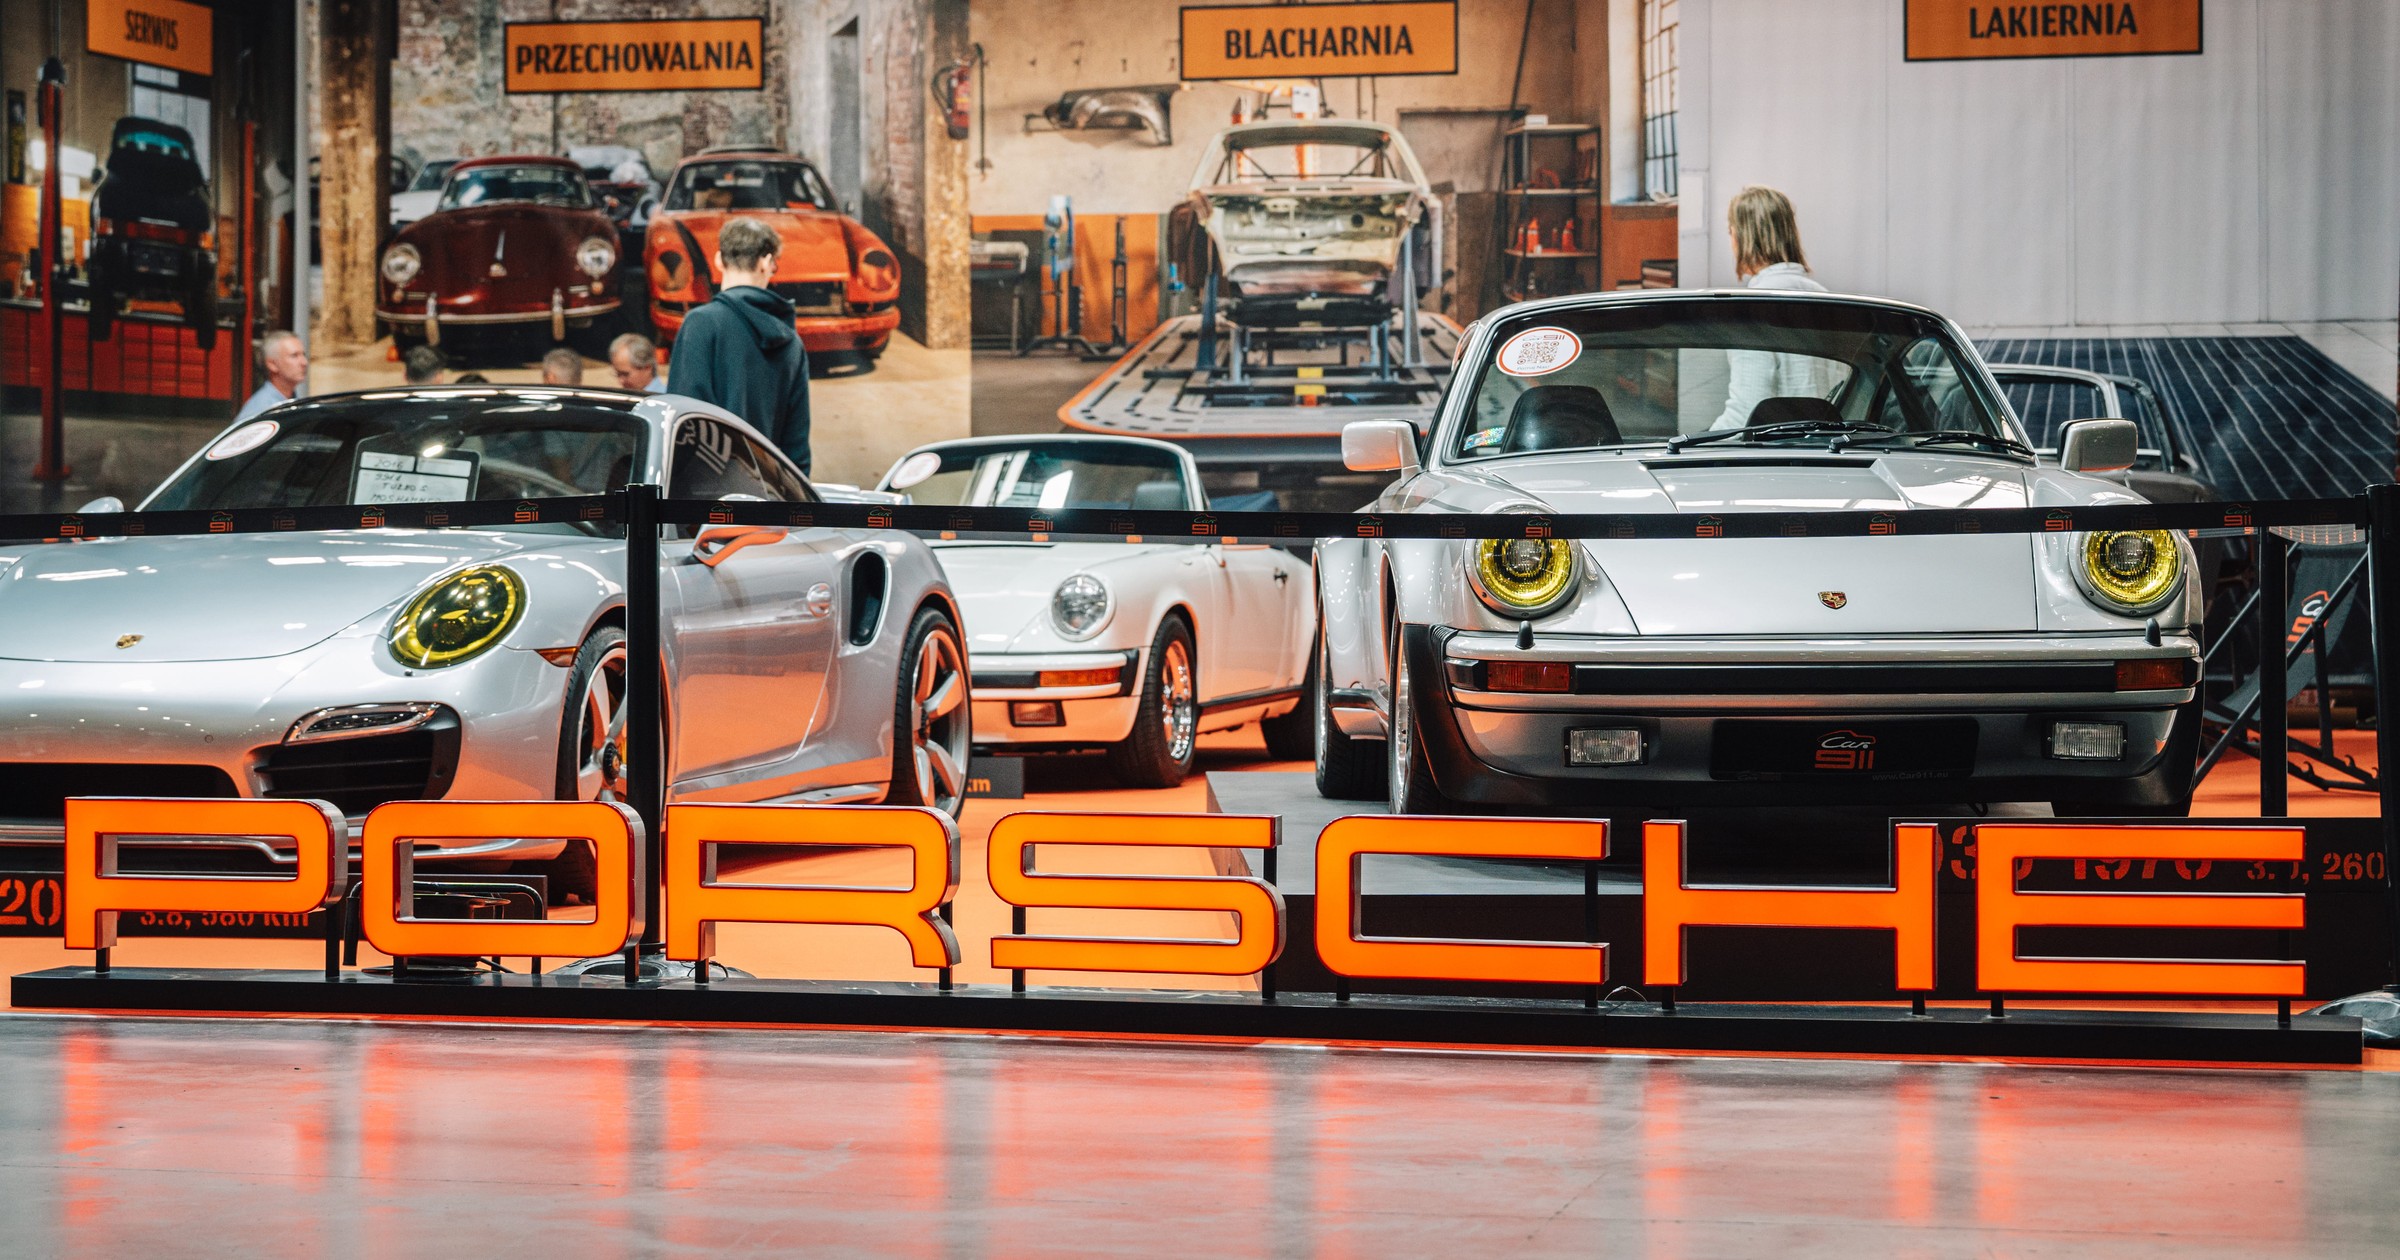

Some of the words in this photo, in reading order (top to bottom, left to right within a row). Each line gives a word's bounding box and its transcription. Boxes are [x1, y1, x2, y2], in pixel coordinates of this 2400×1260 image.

[1969, 3, 2138, 39] LAKIERNIA
[125, 9, 179, 51] SERWIS
[1225, 24, 1414, 60] BLACHARNIA
[515, 39, 754, 74] PRZECHOWALNIA
[361, 516, 385, 527] 911
[514, 511, 539, 522] 911
[709, 512, 733, 523] 911
[867, 516, 892, 527] 911
[2224, 515, 2251, 526] 911
[60, 525, 83, 536] 911
[209, 521, 233, 532] 911
[1028, 520, 1053, 531] 911
[1192, 524, 1217, 535] 911
[1869, 523, 1896, 534] 911
[2045, 520, 2073, 531] 911
[1357, 526, 1383, 537] 911
[1525, 527, 1551, 538] 911
[1696, 526, 1722, 537] 911
[1815, 750, 1875, 769] 911
[2322, 851, 2385, 880] 260
[64, 796, 2307, 996] PORSCHE
